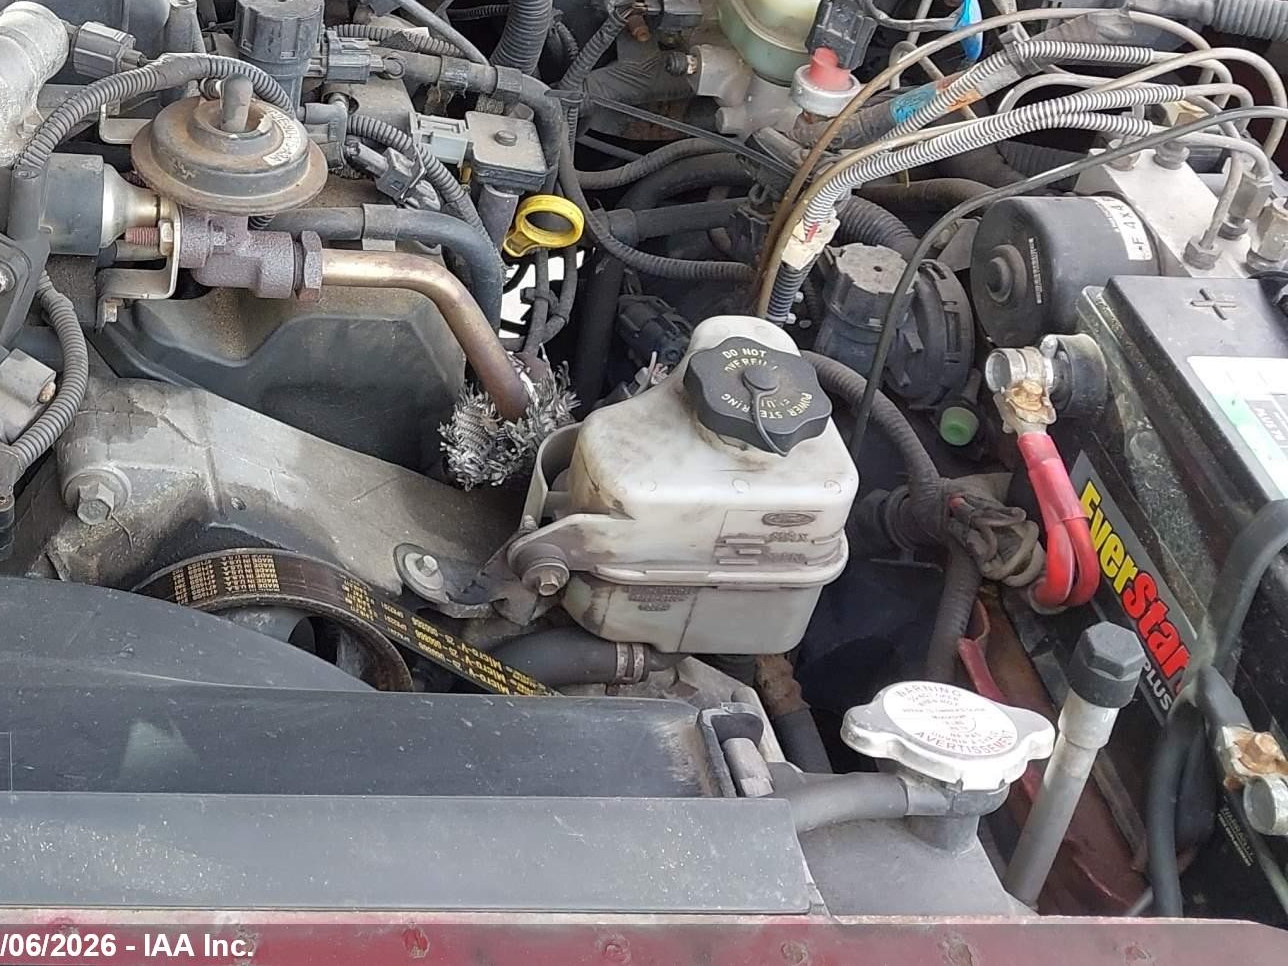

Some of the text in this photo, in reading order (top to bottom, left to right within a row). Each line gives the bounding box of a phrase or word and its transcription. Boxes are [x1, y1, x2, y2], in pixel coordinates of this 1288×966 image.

[722, 347, 767, 359] DO NOT
[721, 393, 783, 419] STERING
[1080, 481, 1191, 699] EverStar
